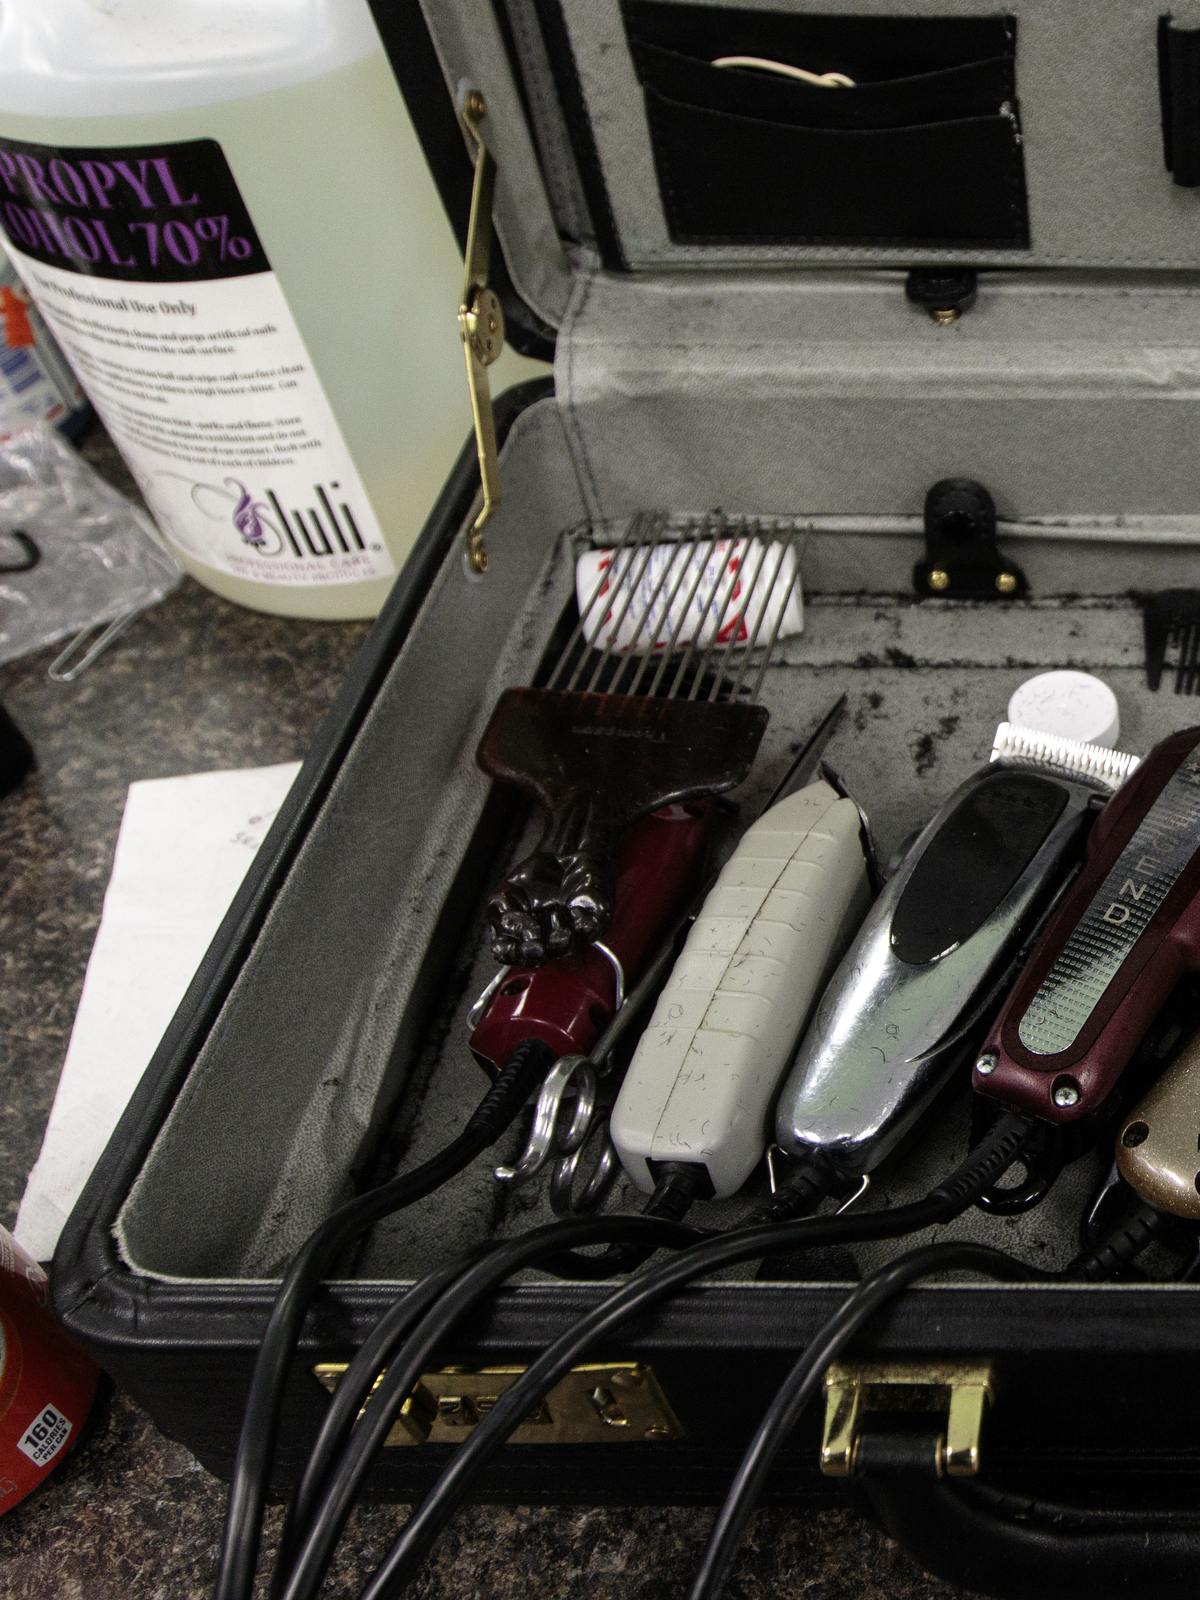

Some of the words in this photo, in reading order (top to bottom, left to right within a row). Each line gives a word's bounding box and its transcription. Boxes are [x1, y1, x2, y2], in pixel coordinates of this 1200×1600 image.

[128, 214, 252, 266] 70%
[50, 281, 128, 312] Professional
[129, 299, 156, 314] Use
[158, 299, 196, 316] Only
[252, 323, 278, 336] nails
[219, 371, 238, 382] nail
[277, 364, 304, 376] clean
[298, 438, 322, 450] with
[24, 1409, 58, 1449] 160
[32, 1418, 67, 1460] CALORIES
[42, 1443, 57, 1460] PER
[56, 1427, 68, 1445] CAN
